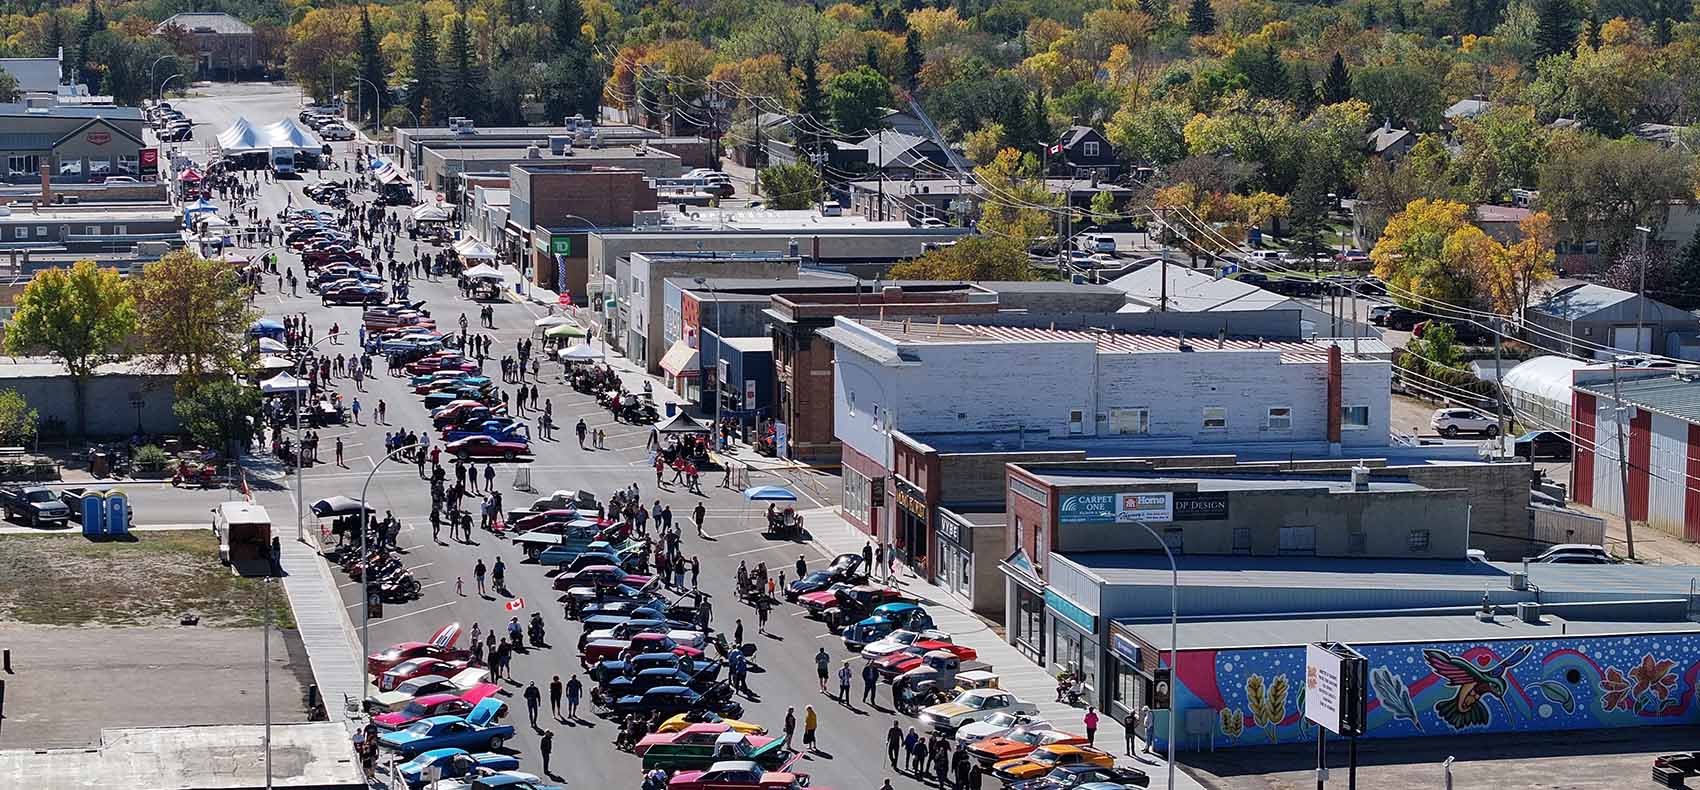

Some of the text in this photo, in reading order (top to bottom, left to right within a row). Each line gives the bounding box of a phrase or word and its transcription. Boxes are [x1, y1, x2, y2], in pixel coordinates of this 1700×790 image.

[554, 241, 568, 251] TD
[1137, 496, 1165, 505] Home
[1175, 501, 1225, 509] DP DESIGN
[1086, 503, 1105, 511] ONE
[941, 517, 957, 538] VYBE
